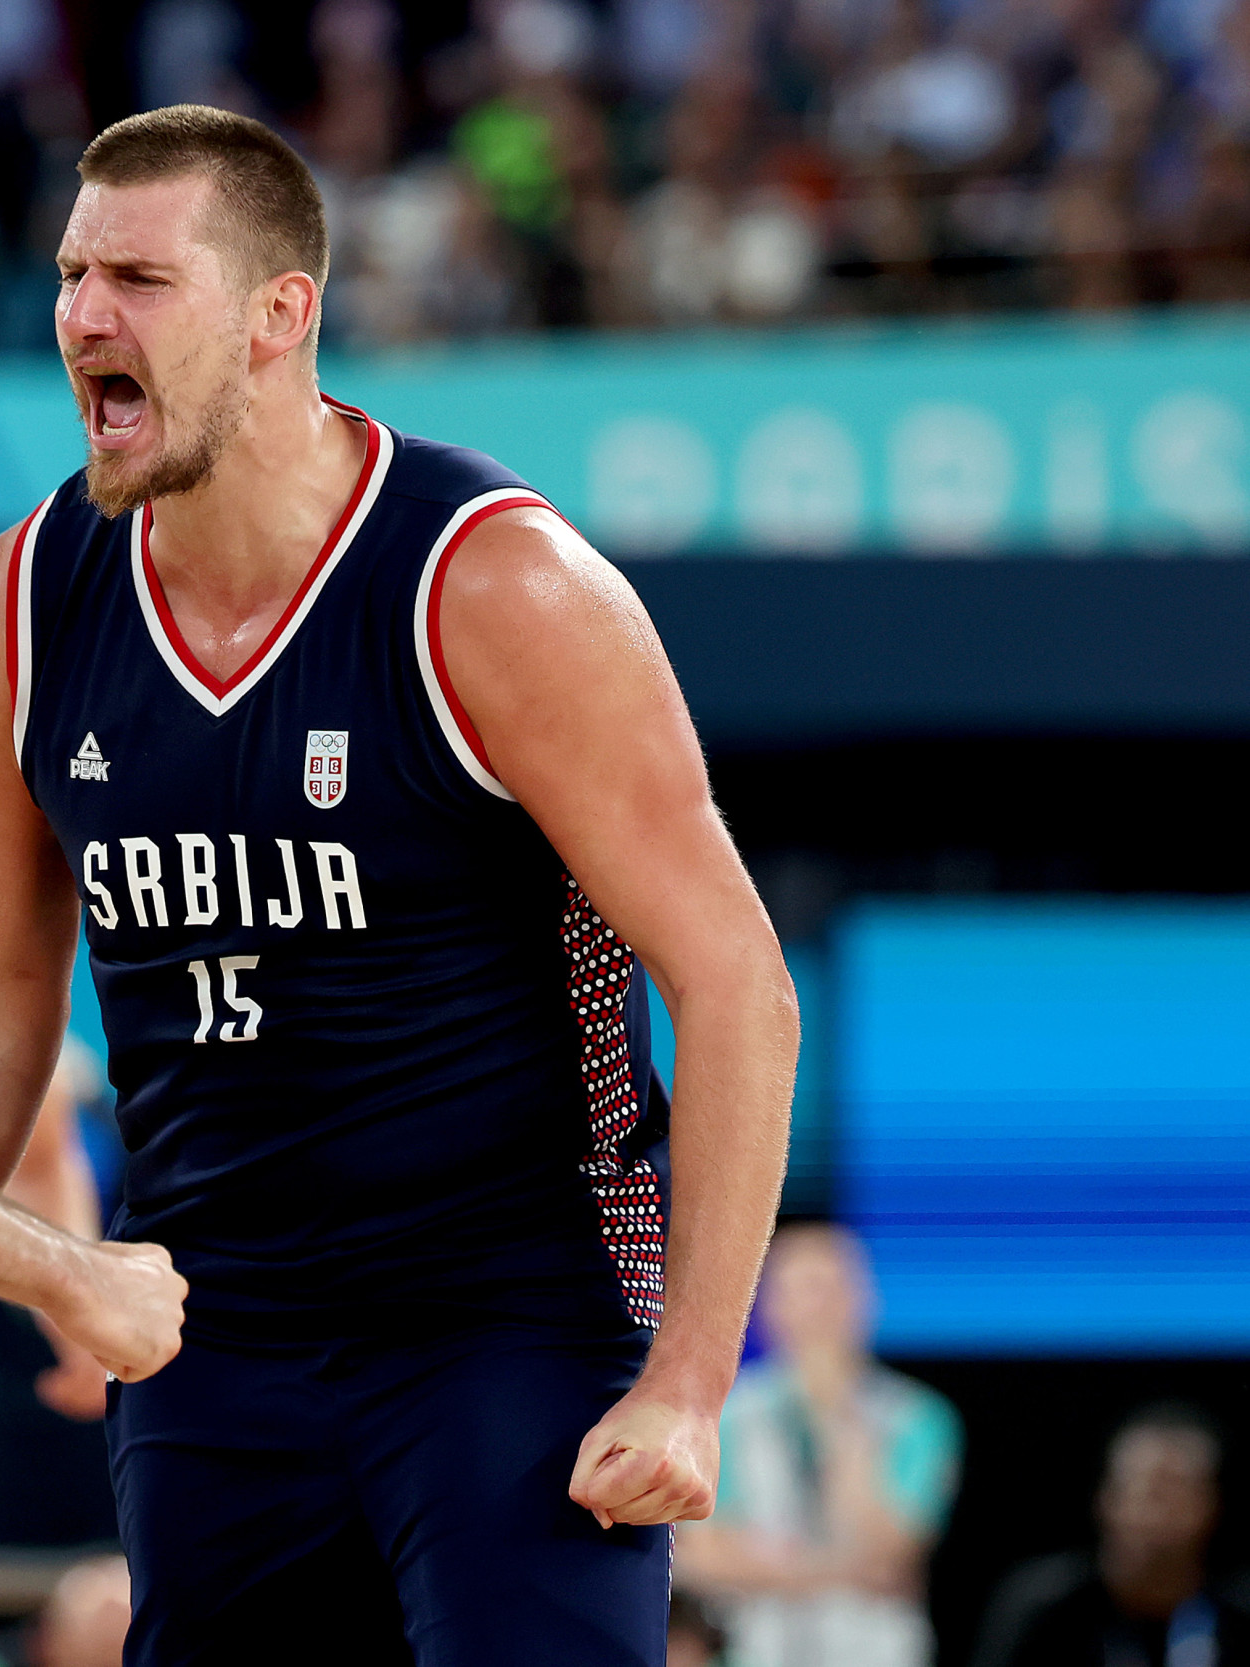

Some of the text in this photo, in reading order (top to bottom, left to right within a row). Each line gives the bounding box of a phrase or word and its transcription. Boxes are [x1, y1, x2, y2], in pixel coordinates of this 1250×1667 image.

[70, 758, 111, 781] PEAK
[83, 833, 367, 930] SRBIJA
[187, 955, 263, 1044] 15
